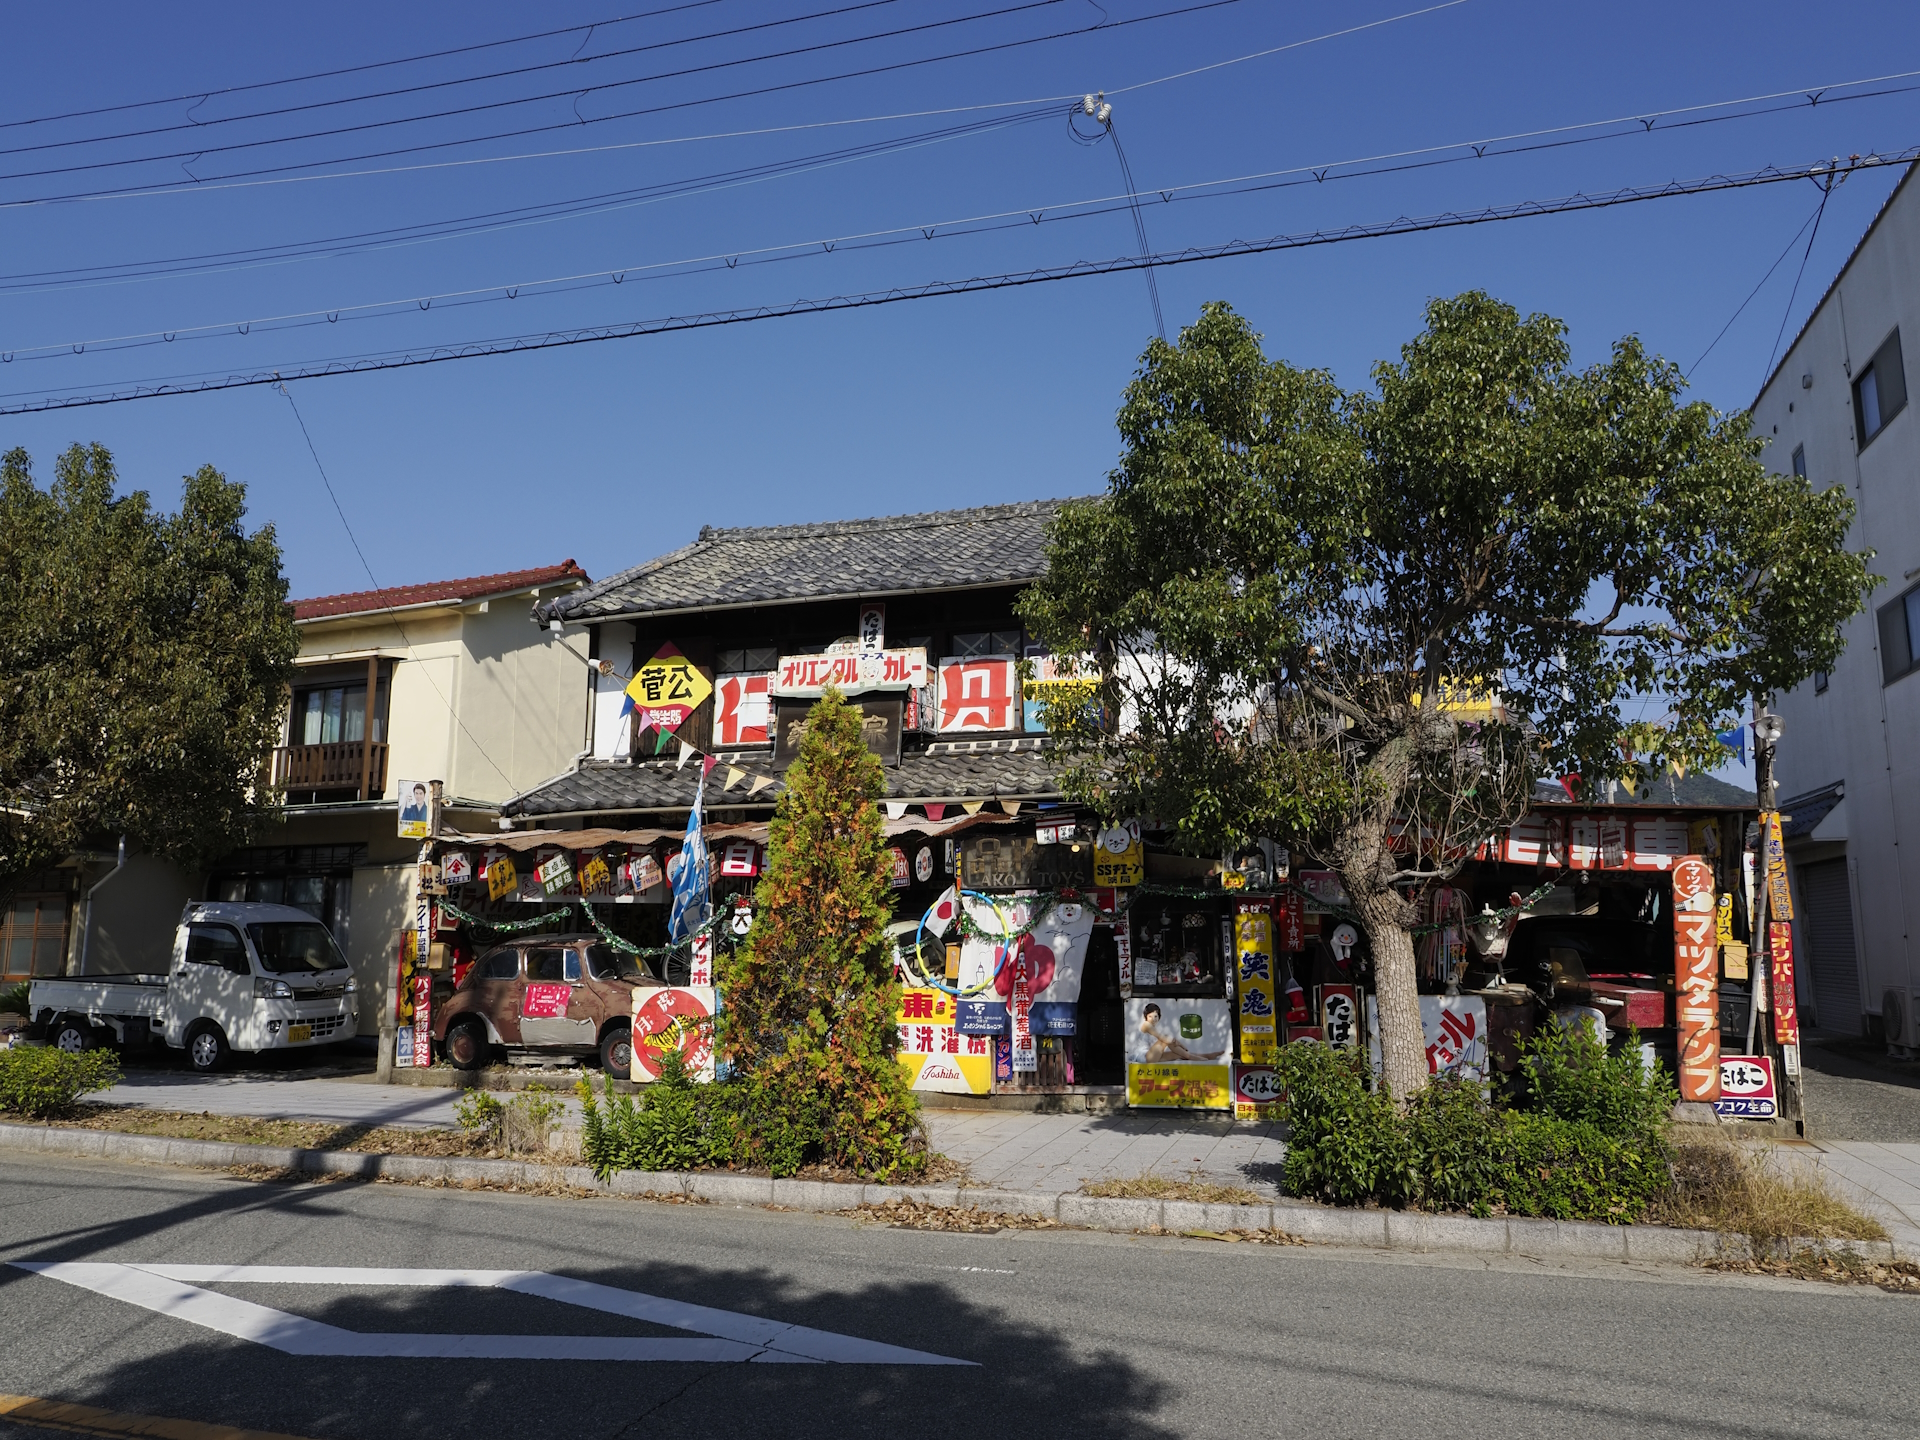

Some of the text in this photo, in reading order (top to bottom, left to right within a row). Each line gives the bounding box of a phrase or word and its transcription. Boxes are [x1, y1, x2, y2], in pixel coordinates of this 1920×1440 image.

[859, 653, 884, 661] マース
[640, 665, 694, 701] 菅公
[782, 656, 921, 688] オリエンタル カレー
[717, 676, 768, 743] 仁
[940, 658, 1012, 729] 丹
[541, 856, 568, 878] 食卓塩
[723, 843, 752, 874] 自
[546, 871, 573, 895] 精製塩
[982, 872, 1084, 887] AKO TOYS
[1685, 863, 1703, 895] マツダ
[1719, 909, 1730, 935] ソース
[1120, 940, 1130, 979] キャラメル
[1015, 965, 1032, 1050] 大黒葡萄酒
[1678, 915, 1718, 1097] マツダランプ
[916, 1026, 987, 1055] 洗濯機
[922, 1065, 960, 1080] Toshiba
[1137, 1069, 1179, 1077] かとり線香
[1720, 1065, 1764, 1086] たばこ
[1138, 1078, 1219, 1099] アース渦巻
